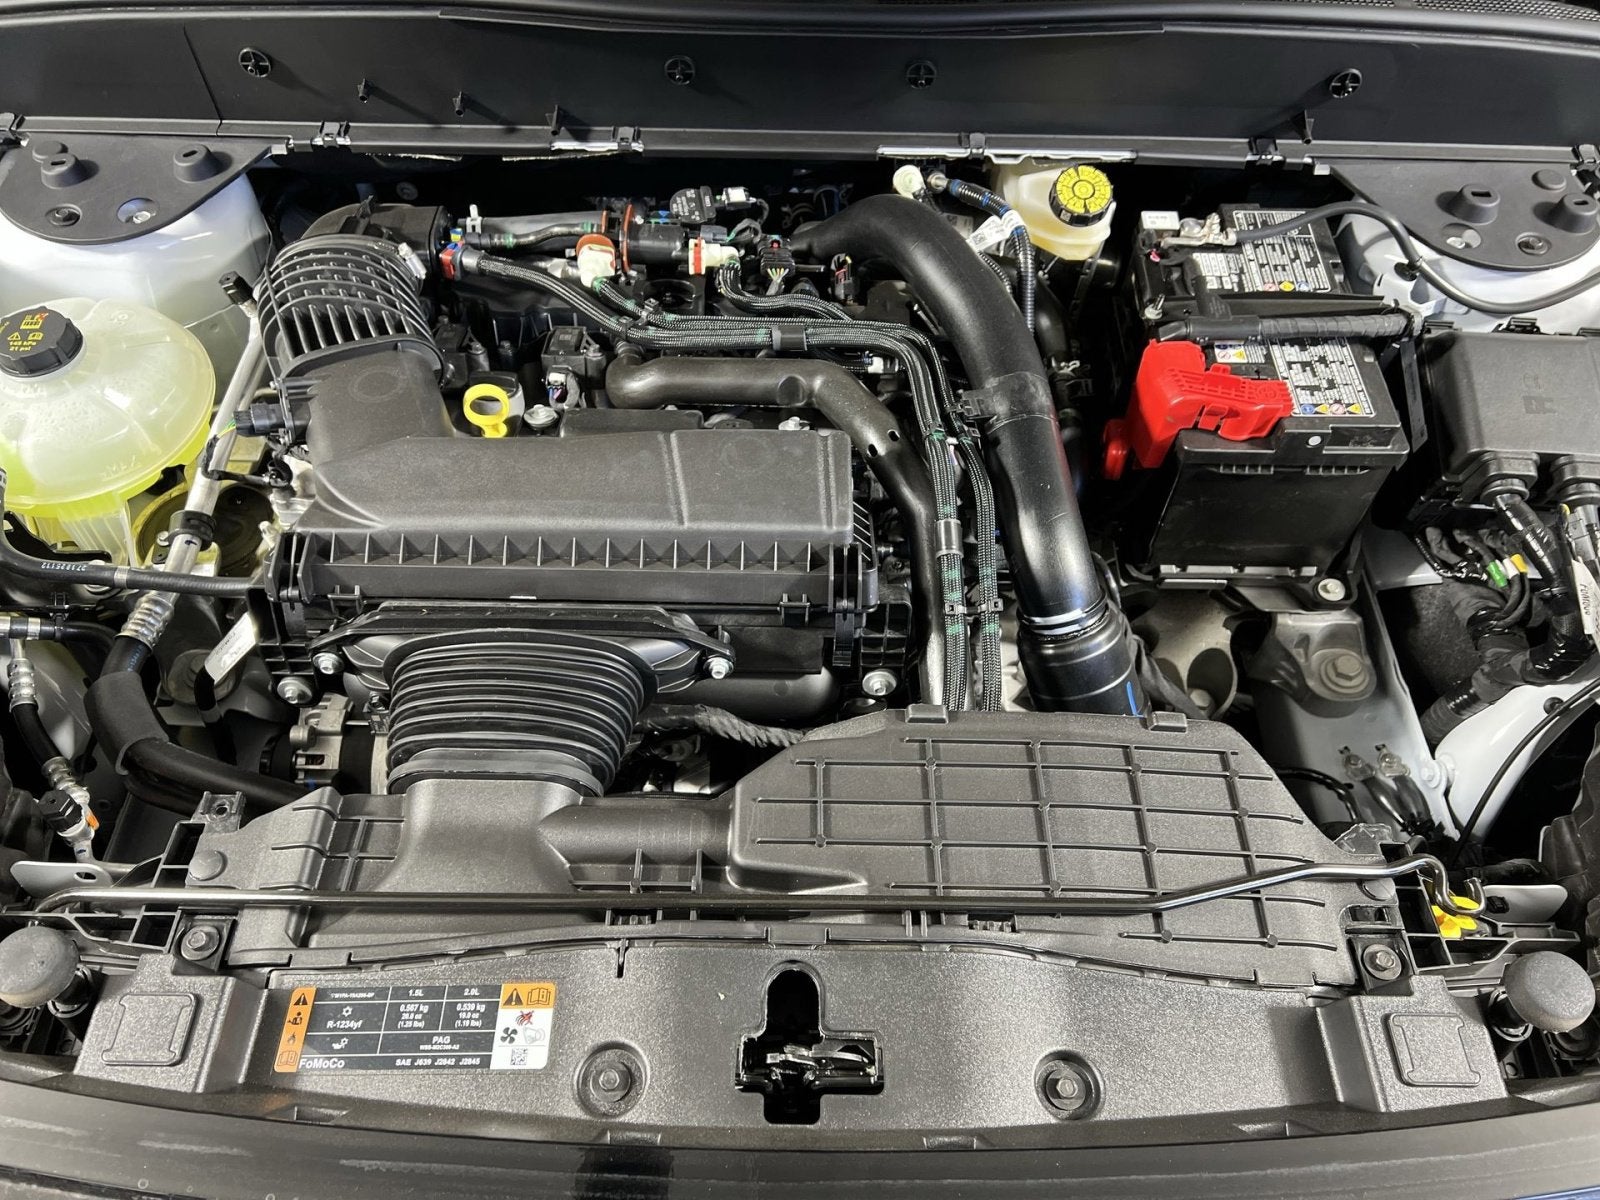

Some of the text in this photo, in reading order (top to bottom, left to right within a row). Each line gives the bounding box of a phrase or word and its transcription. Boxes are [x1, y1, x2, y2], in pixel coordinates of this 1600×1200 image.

[408, 989, 424, 997] 1.5L
[463, 988, 480, 996] 2.0L
[419, 1004, 429, 1013] kg
[456, 1003, 486, 1012] 0.539 kg
[326, 1020, 363, 1030] R-1234yf
[413, 1020, 425, 1029] lbs)
[470, 1019, 482, 1028] lbs)
[431, 1036, 451, 1044] PAG
[298, 1057, 345, 1069] FoMoCo
[395, 1057, 480, 1066] SAE J639 J2842 J2845
